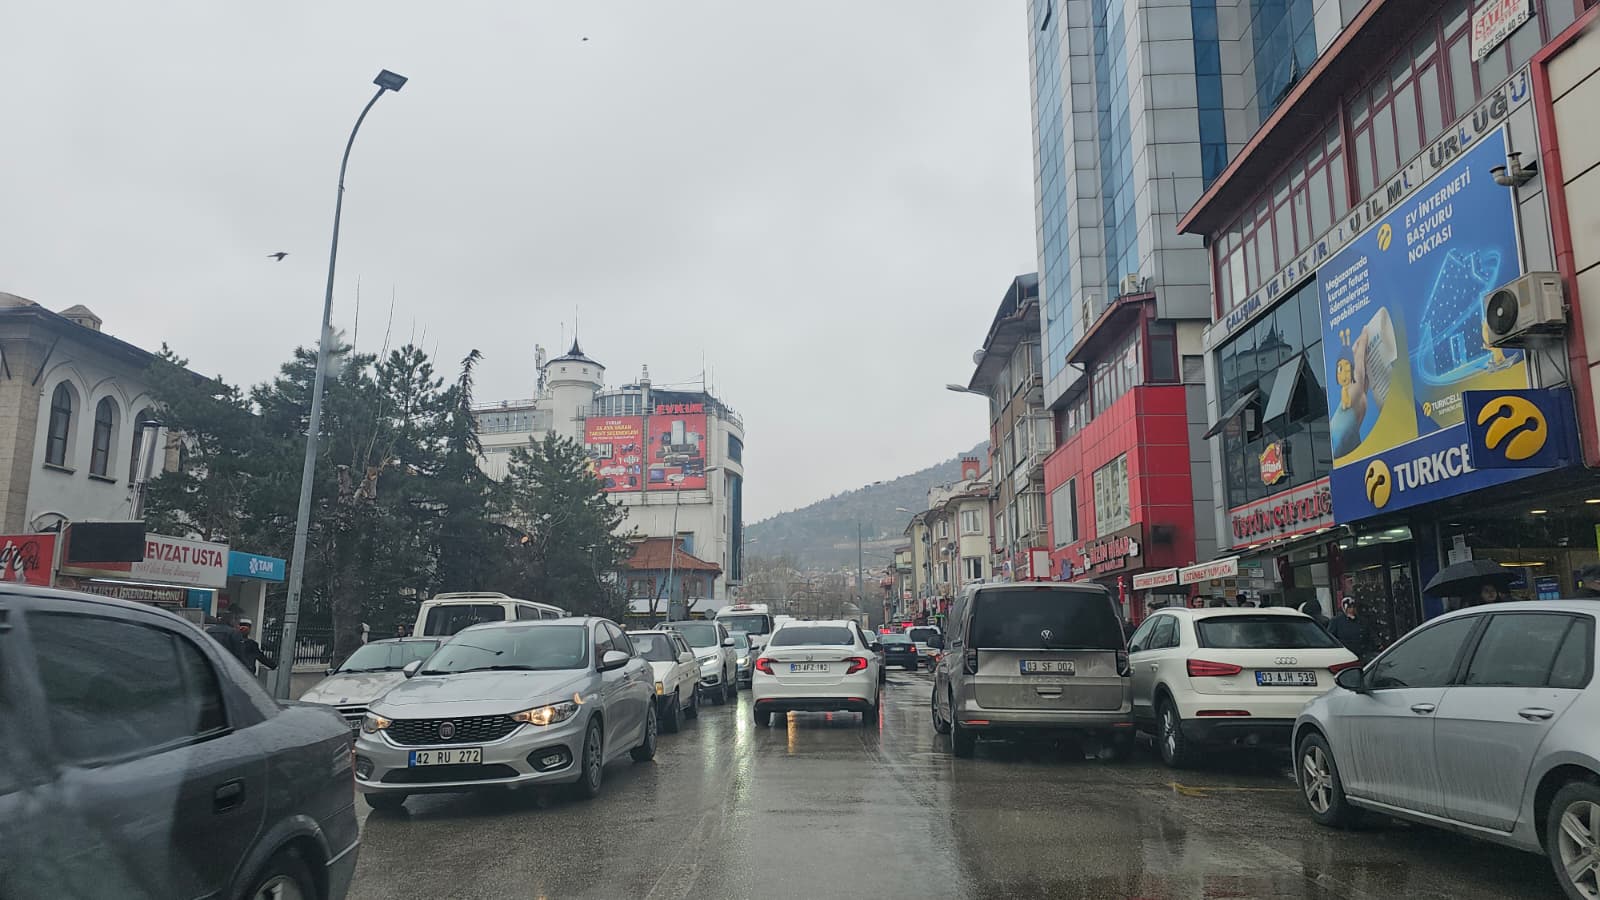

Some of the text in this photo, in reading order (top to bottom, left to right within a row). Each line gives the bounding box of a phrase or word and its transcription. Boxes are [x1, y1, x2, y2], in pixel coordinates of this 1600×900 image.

[1405, 166, 1471, 229] EV İNTERNETİ
[1406, 203, 1453, 246] BAŞVURU
[1408, 224, 1452, 265] NOKTASI
[1327, 269, 1369, 302] kurum fatura
[1226, 295, 1261, 334] ÇALIŞMA
[1266, 278, 1280, 299] VE
[191, 547, 223, 567] USTA
[1027, 662, 1073, 671] 03 SF 002
[1262, 672, 1273, 682] 03
[1297, 672, 1315, 682] 539
[416, 750, 479, 764] 42 RU 272
